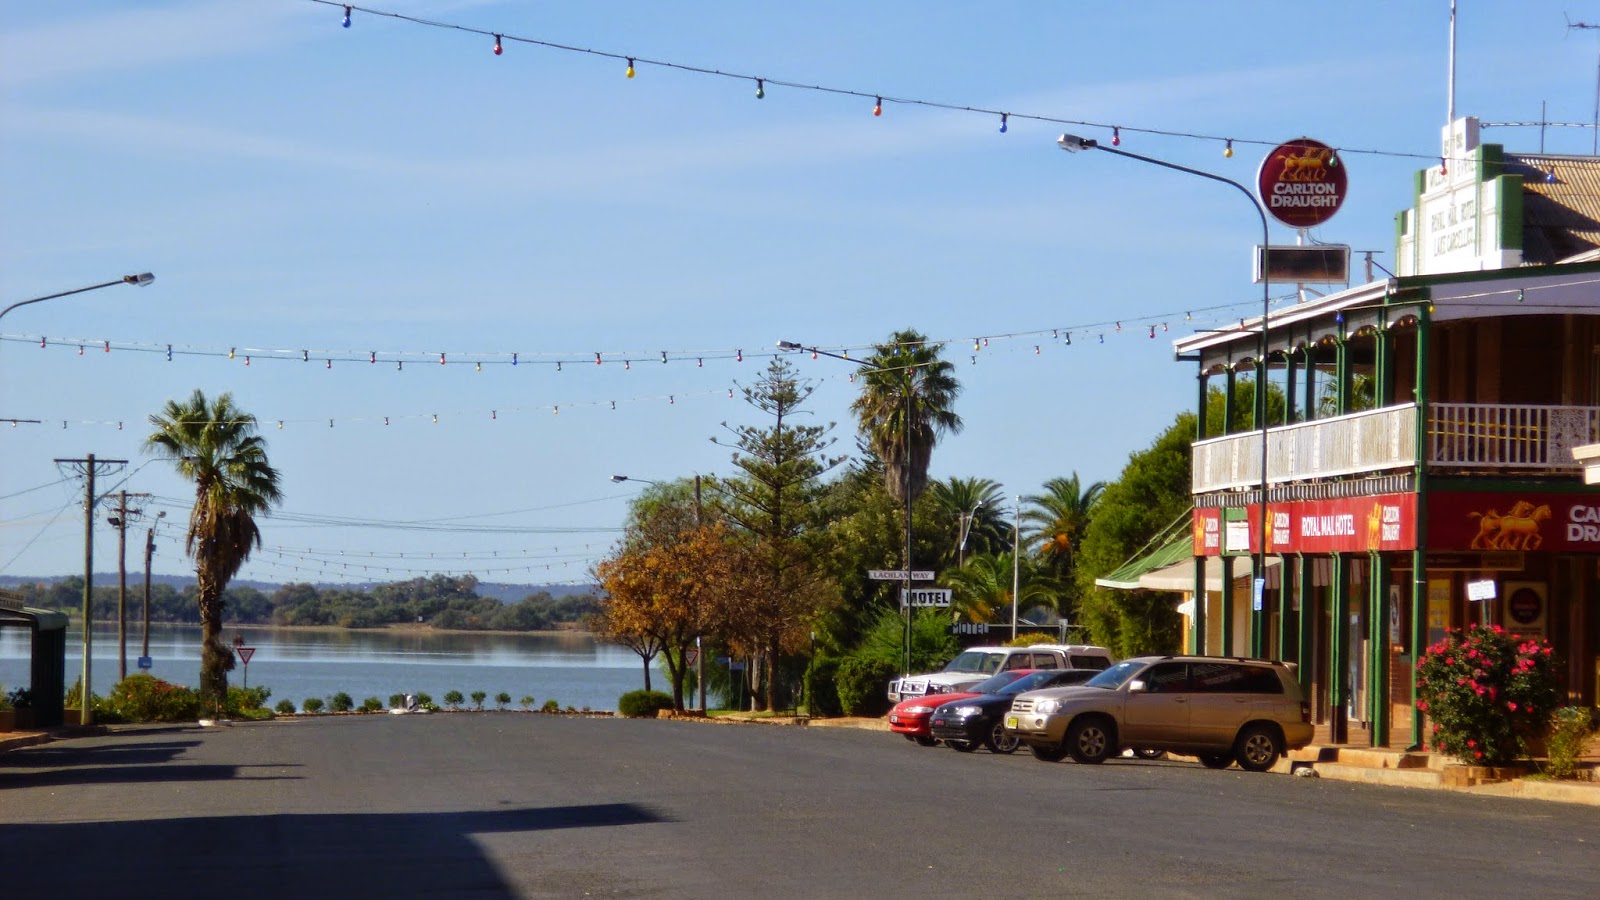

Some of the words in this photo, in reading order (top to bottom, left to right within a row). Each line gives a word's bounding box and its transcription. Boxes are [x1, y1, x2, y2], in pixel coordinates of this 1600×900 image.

[1274, 183, 1336, 194] CARLTON
[1271, 195, 1339, 207] DRAUGHT
[1569, 505, 1600, 523] CA
[1302, 516, 1321, 537] ROYAL
[1335, 514, 1355, 535] HOTEL
[906, 592, 949, 604] MOTEL
